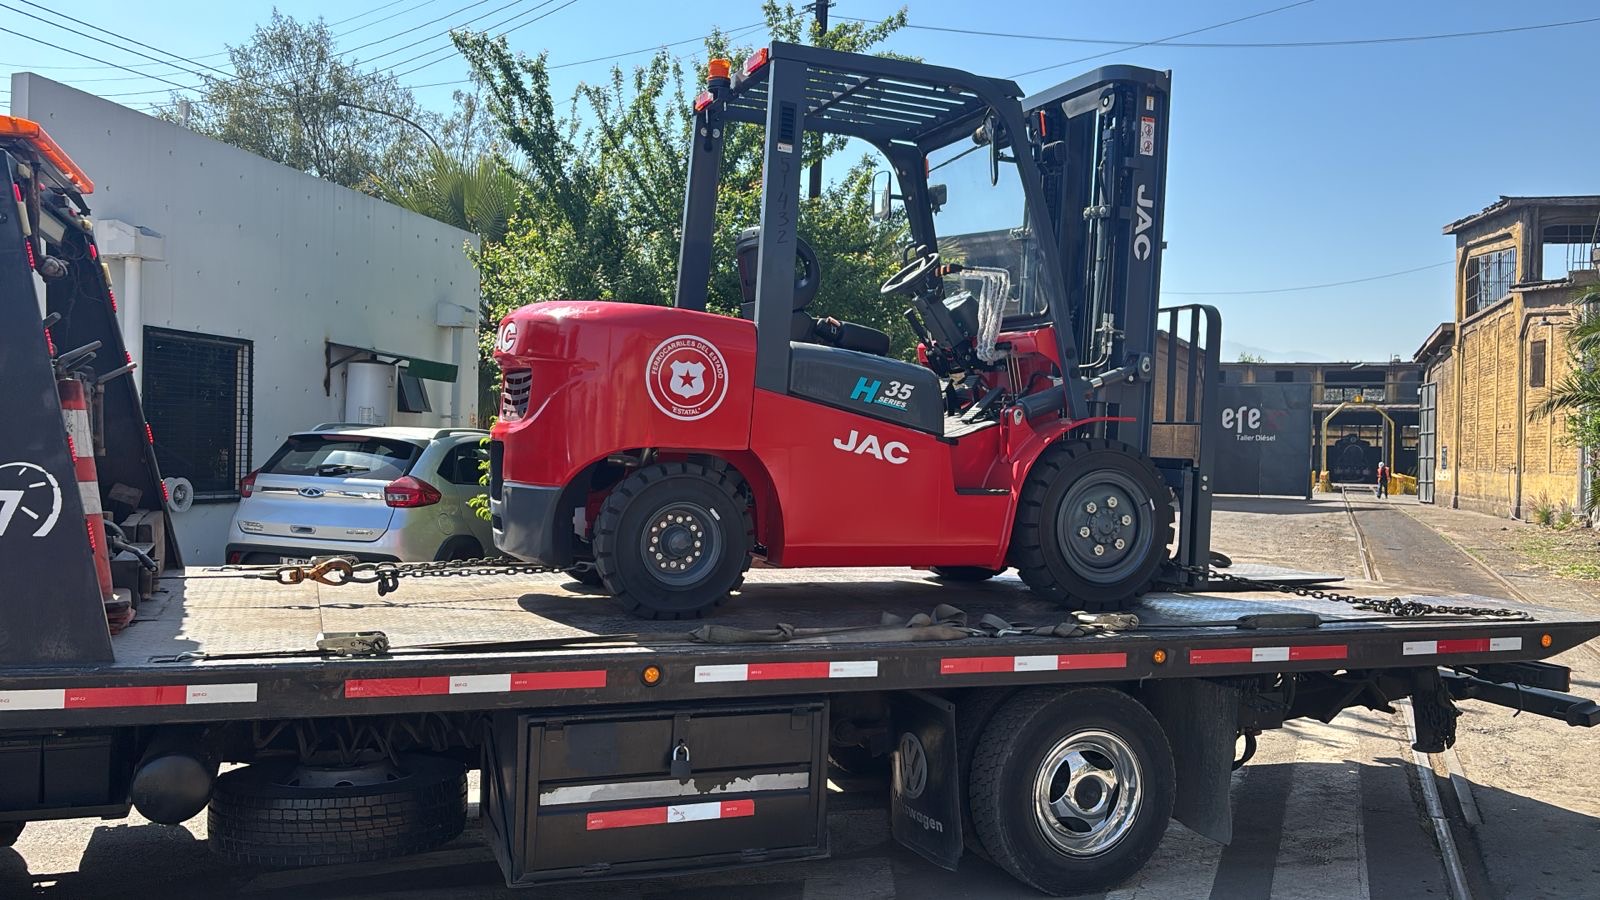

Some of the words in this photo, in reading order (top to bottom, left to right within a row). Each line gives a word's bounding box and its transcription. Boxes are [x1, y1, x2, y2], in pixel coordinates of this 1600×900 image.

[1133, 184, 1154, 261] JAC
[652, 340, 696, 375] FERROCARRILES
[697, 342, 709, 354] DEL
[709, 352, 724, 379] ESTADO
[850, 376, 881, 403] H
[884, 380, 915, 400] 35
[878, 396, 907, 408] SERIES
[1221, 406, 1261, 434] efe
[833, 429, 910, 465] JAC
